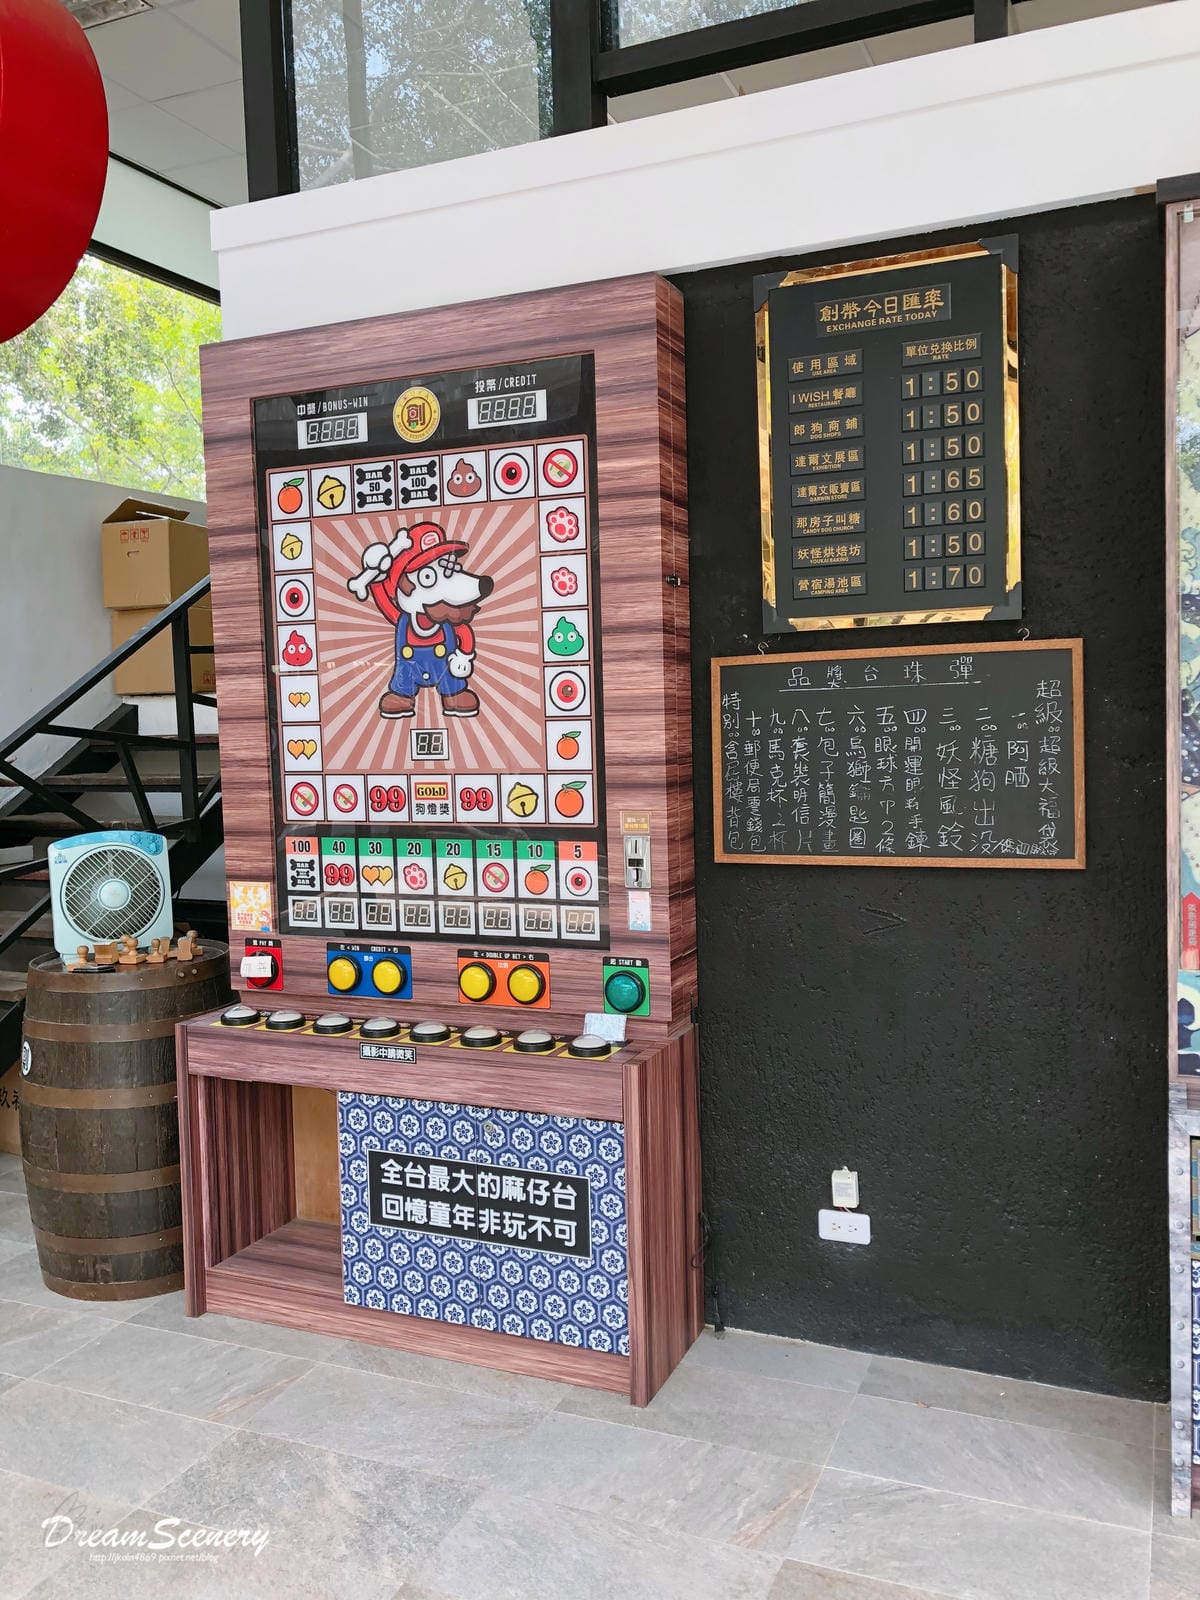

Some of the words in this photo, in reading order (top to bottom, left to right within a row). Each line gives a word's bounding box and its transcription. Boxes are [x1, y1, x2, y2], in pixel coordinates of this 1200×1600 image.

[819, 288, 945, 322] 創幣今日匯率
[826, 318, 877, 333] EXCHANGE
[878, 314, 903, 325] RATE
[905, 310, 938, 321] TODAY
[792, 353, 857, 374] 使用區域
[932, 353, 950, 361] RATE
[906, 370, 979, 396] 1:50
[799, 390, 830, 403] WISH
[808, 399, 841, 408] RESTAURANT
[906, 403, 980, 428] 1:50
[810, 432, 822, 440] DOG
[907, 436, 981, 461] 1:50
[794, 449, 859, 468] 達爾文展區
[409, 466, 428, 475] BAR
[812, 463, 842, 471] EXHIBITION
[365, 471, 383, 479] BAR
[907, 468, 981, 493] 1:65
[369, 482, 380, 492] 50
[411, 477, 427, 488] 100
[366, 494, 384, 503] BAR
[410, 490, 429, 499] BAR
[907, 501, 982, 525] 1:60
[796, 512, 861, 529] 那房子叫糖
[908, 533, 982, 557] 1:50
[797, 544, 862, 561] 妖怪烘焙坊
[908, 566, 982, 589] 1:70
[369, 784, 407, 813] 99
[417, 786, 447, 797] GOLD
[459, 786, 494, 812] 99
[292, 839, 311, 853] 100
[332, 840, 346, 854] 40
[368, 841, 382, 855] 30
[407, 842, 421, 856] 20
[446, 843, 461, 857] 20
[486, 843, 501, 858] 15
[528, 844, 542, 858] 10
[574, 845, 582, 859] 5
[324, 862, 355, 887] 99
[381, 1193, 577, 1247] 回憶童年非玩不可
